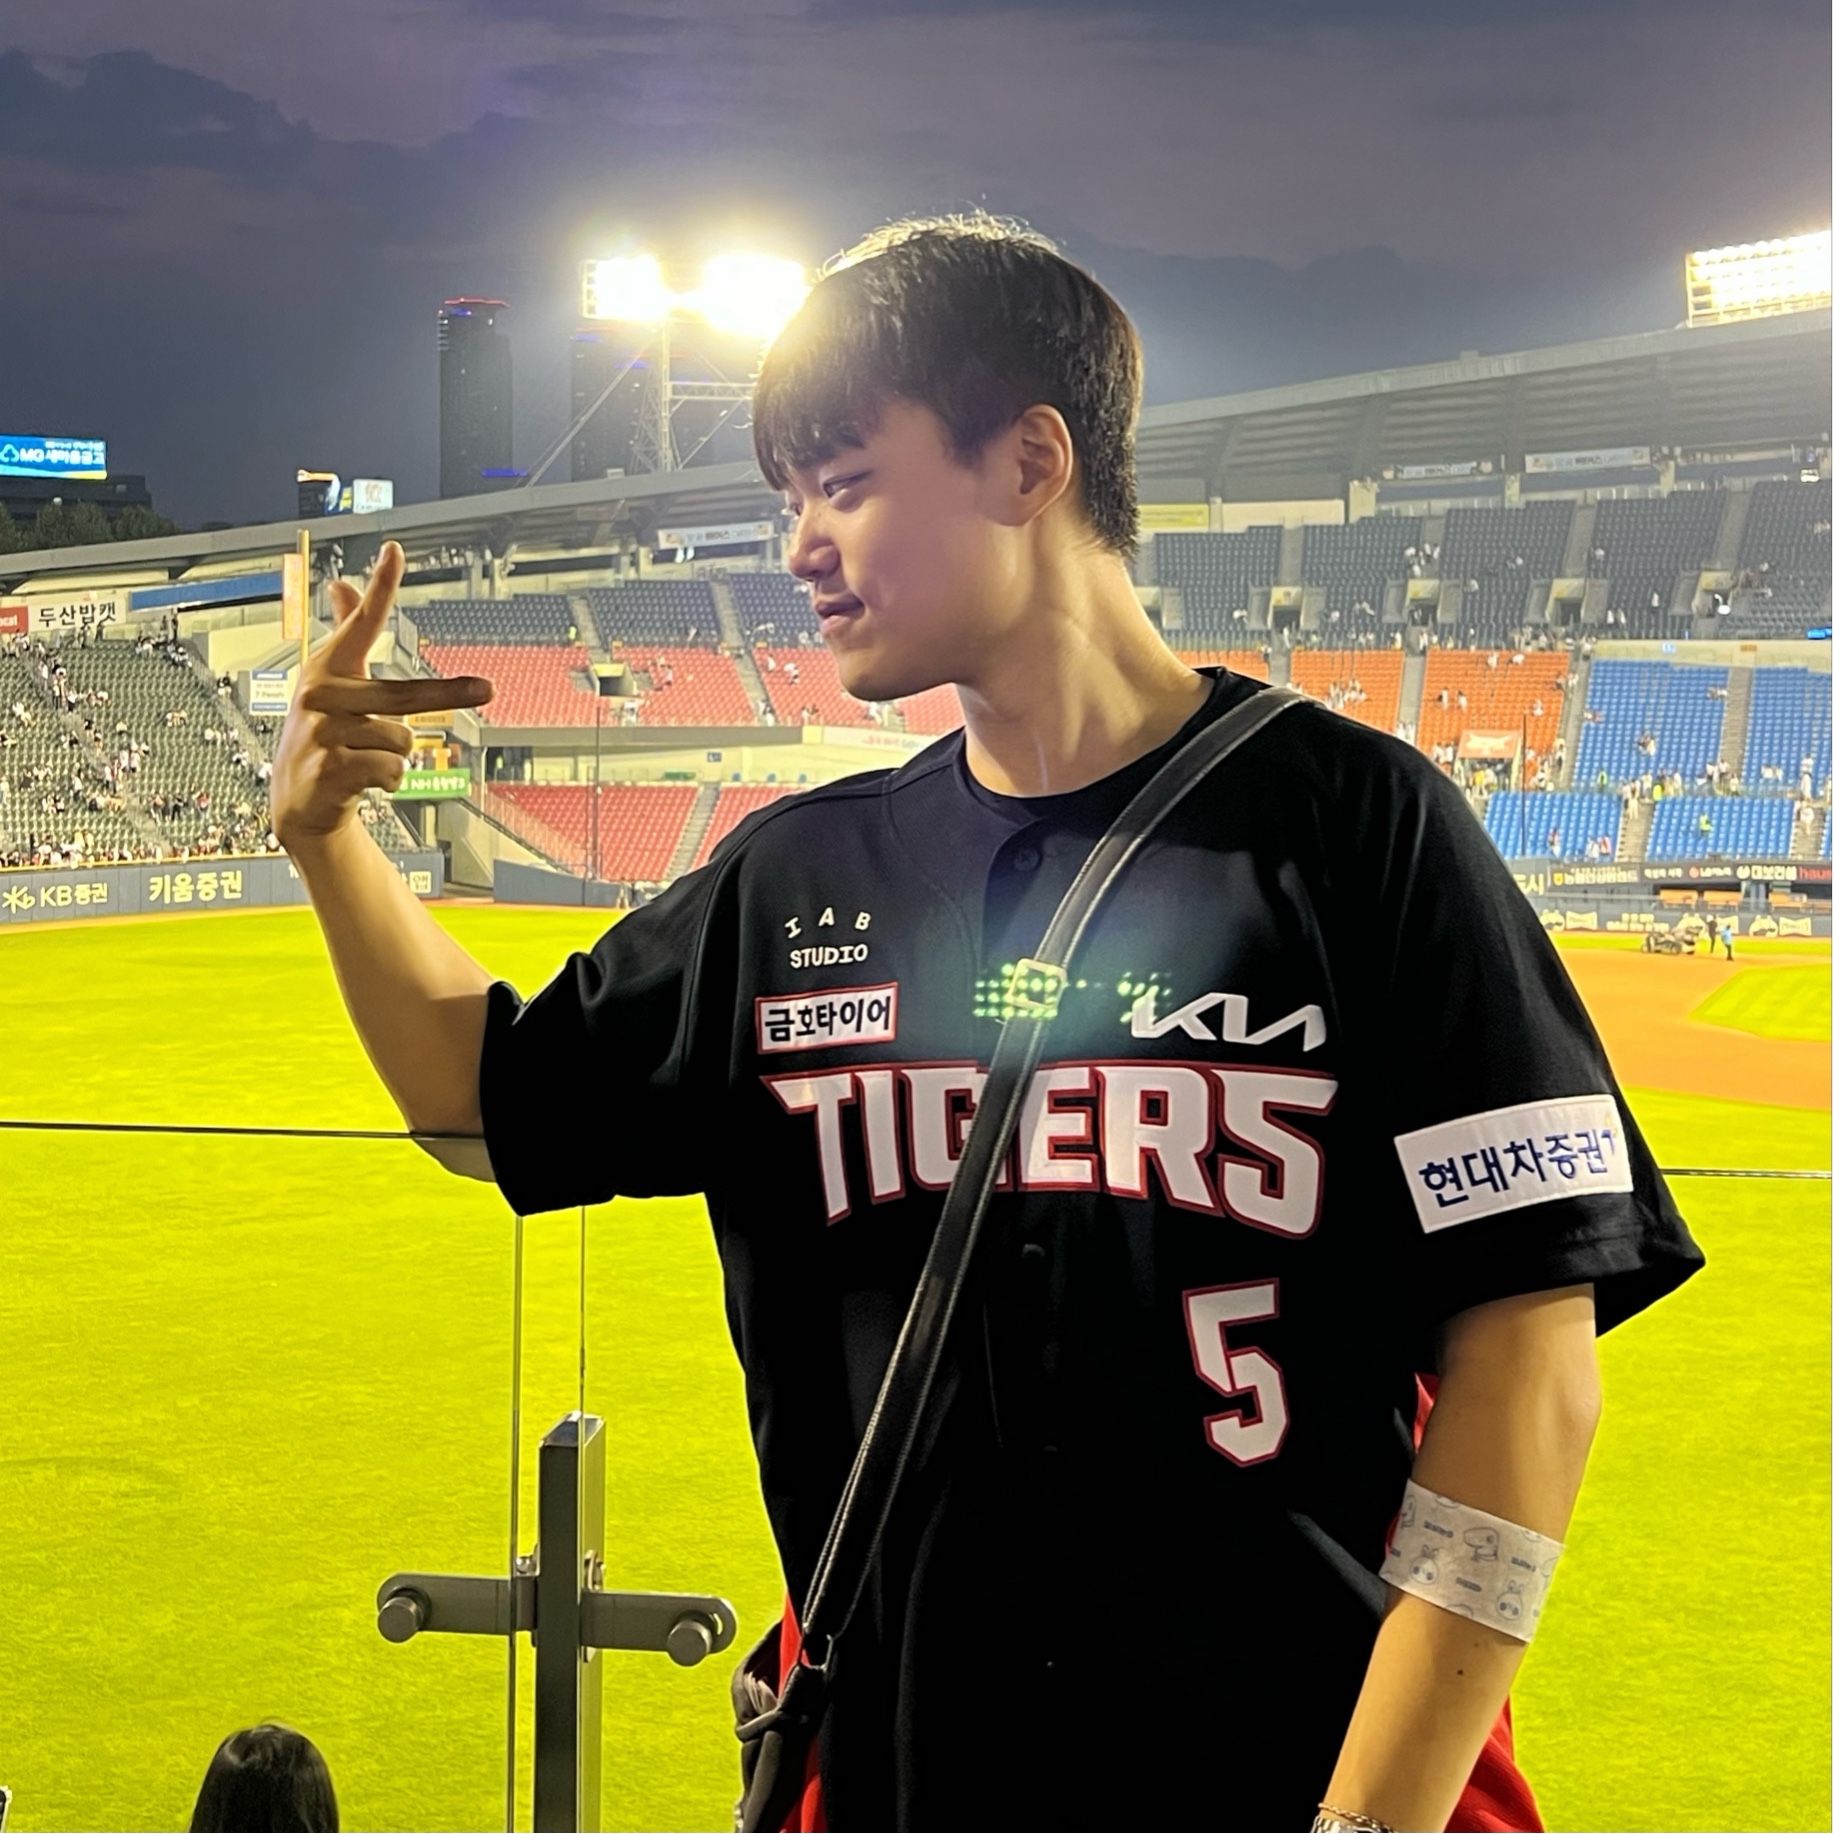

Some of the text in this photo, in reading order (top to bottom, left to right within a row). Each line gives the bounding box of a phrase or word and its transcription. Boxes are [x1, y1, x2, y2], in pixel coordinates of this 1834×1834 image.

[39, 601, 116, 628] 두산밥캣
[40, 882, 108, 908] KB증권
[149, 870, 243, 905] 키움증권
[789, 943, 869, 969] STUDIO
[763, 996, 892, 1043] 금호타이어
[1131, 992, 1327, 1052] KIA
[759, 1059, 1338, 1239] TIGERS
[1418, 1128, 1608, 1208] 현대차증권
[1182, 1277, 1290, 1468] 5
